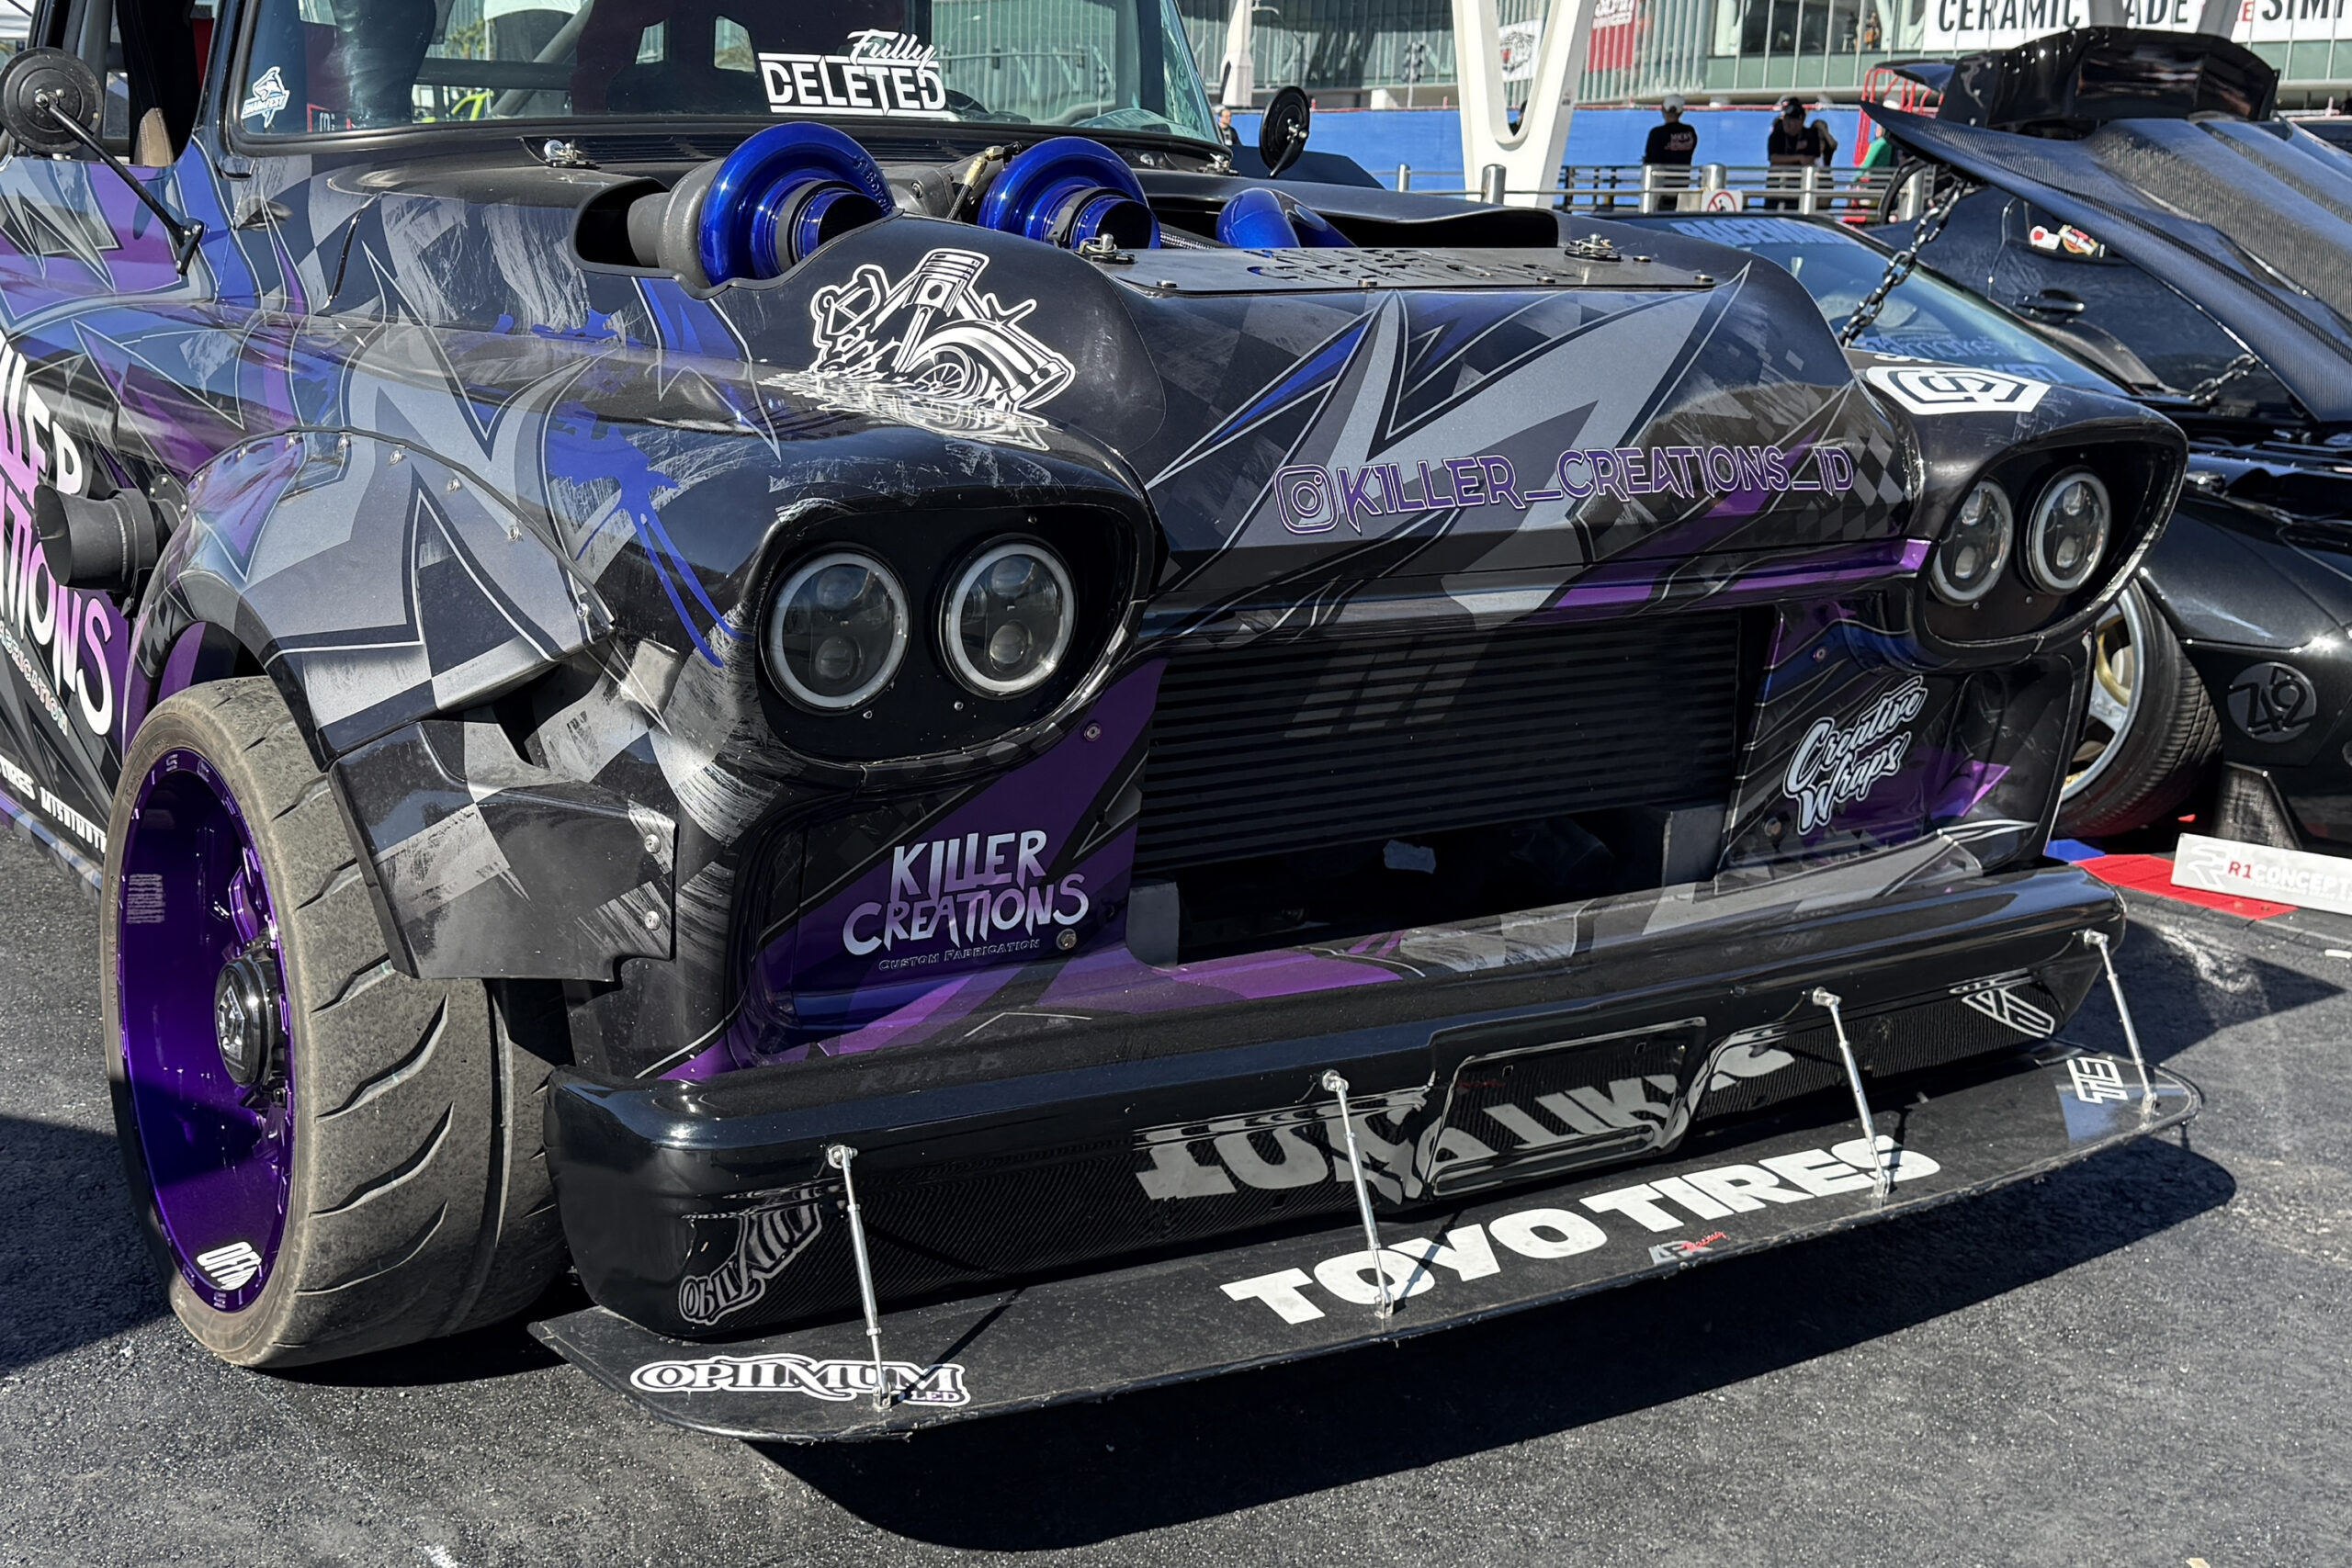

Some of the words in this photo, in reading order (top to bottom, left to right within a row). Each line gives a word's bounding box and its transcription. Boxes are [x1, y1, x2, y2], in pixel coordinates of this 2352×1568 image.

[1938, 0, 2080, 32] CERAMIC
[2123, 0, 2188, 25] ADE
[846, 28, 937, 73] Fully
[760, 55, 946, 116] DELETED
[1783, 674, 1928, 798] Creative
[1796, 731, 1912, 836] Wraps
[889, 829, 1047, 904] KILLER
[842, 873, 1090, 956] CREATIONS
[1219, 1208, 1609, 1325] TOYO
[1578, 1134, 1941, 1234] TIRES
[639, 1359, 957, 1398] OPTIMUM
[910, 1390, 961, 1403] LED
